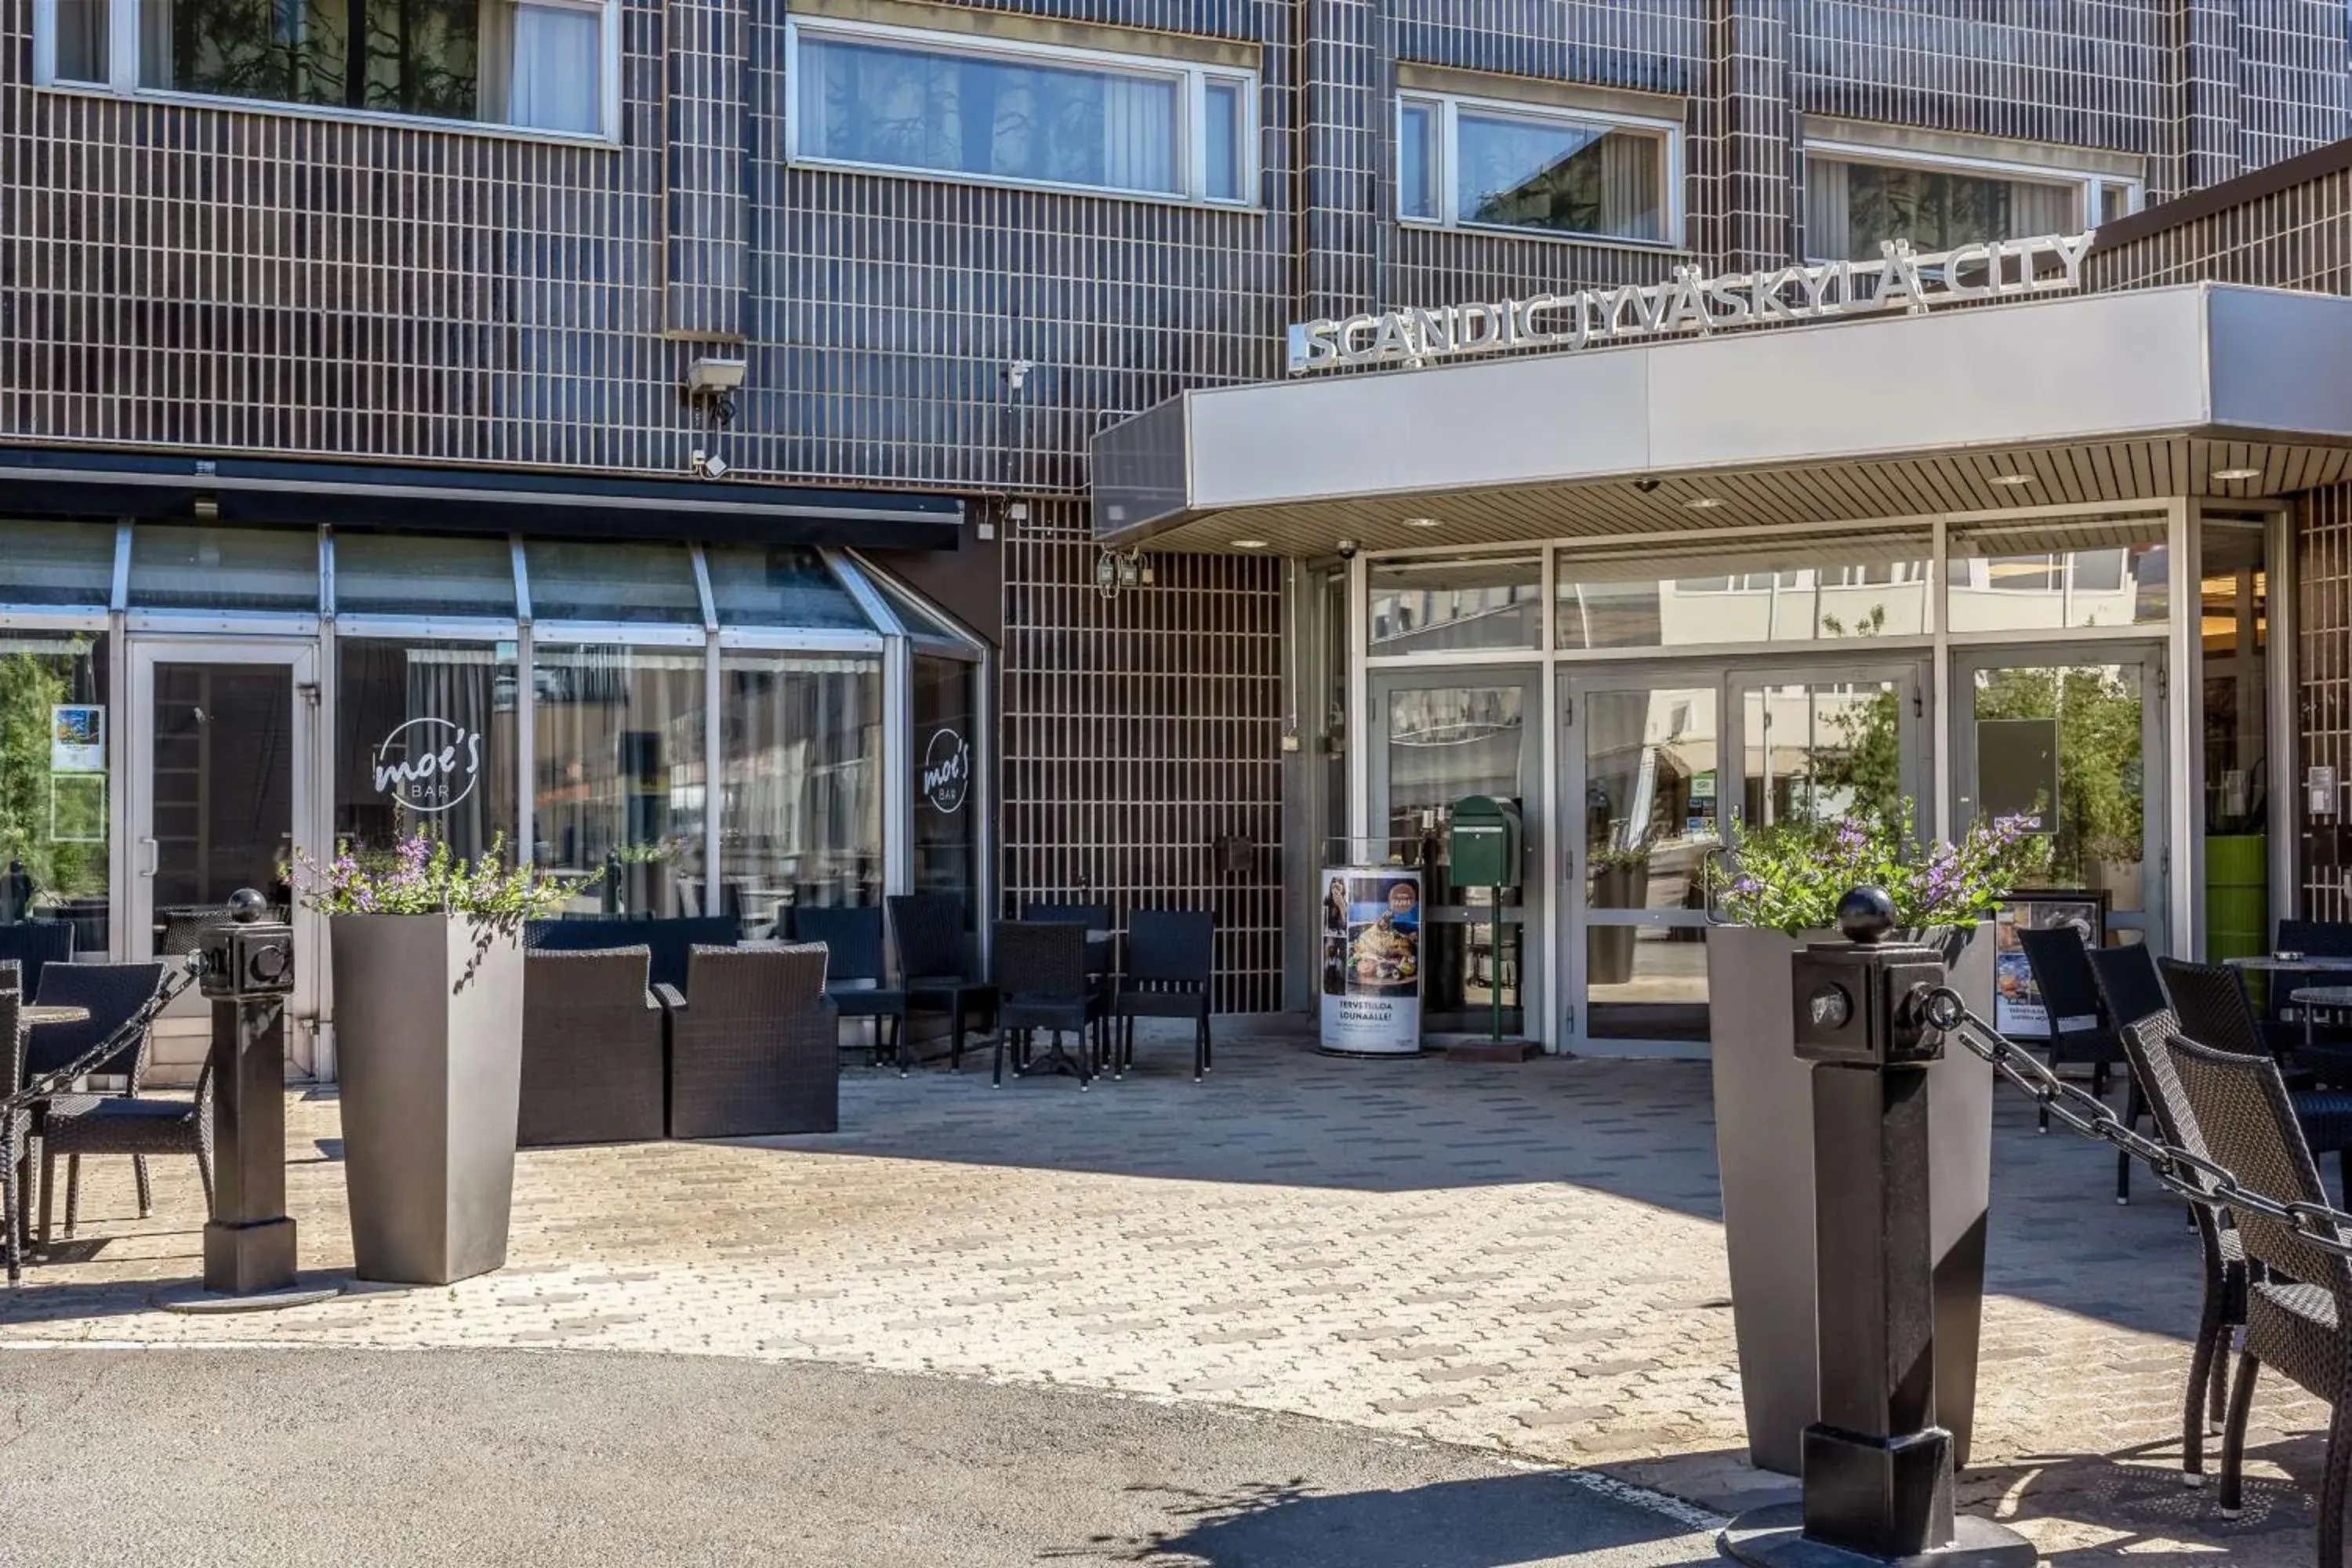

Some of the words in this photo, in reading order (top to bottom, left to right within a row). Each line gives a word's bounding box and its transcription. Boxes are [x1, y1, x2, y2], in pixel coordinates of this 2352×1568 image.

[1305, 292, 1556, 365] SCANDIC
[1568, 238, 1924, 350] JYVÄSKYLÄ
[1944, 227, 2096, 296] CITY
[412, 785, 450, 797] BAR
[938, 788, 956, 800] BAR
[1339, 1000, 1393, 1011] TERVETULOA
